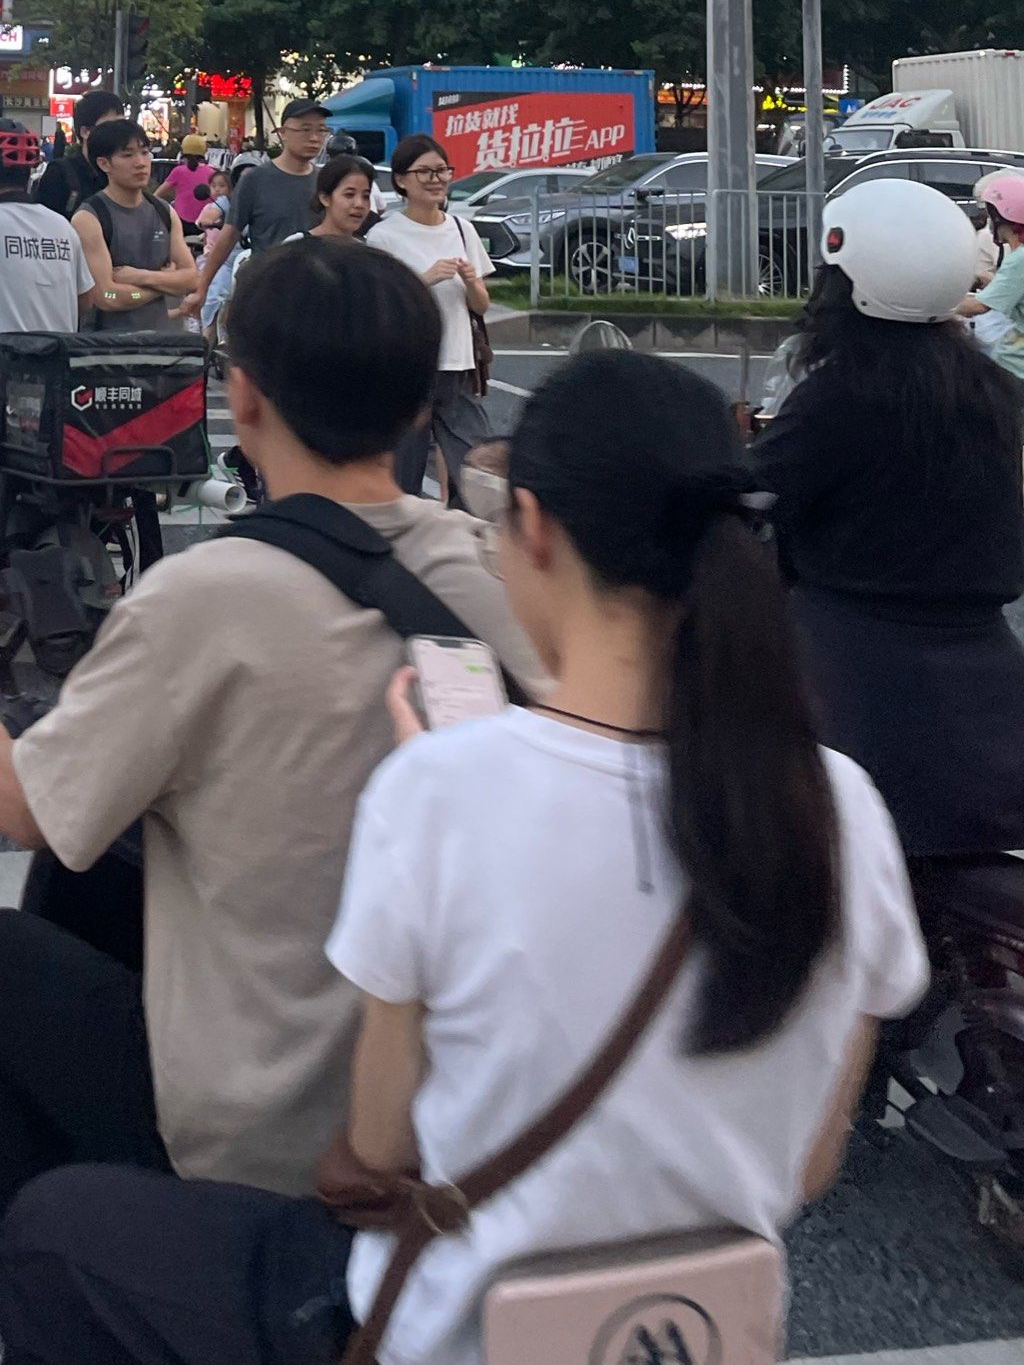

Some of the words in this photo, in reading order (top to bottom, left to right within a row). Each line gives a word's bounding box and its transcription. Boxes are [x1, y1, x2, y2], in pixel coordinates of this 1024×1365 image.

[870, 96, 921, 110] JAC
[446, 103, 519, 137] 拉货就找
[473, 117, 576, 172] 货拉拉
[585, 124, 625, 151] APP
[5, 236, 71, 261] 同城急送
[95, 387, 142, 402] 顺丰同城
